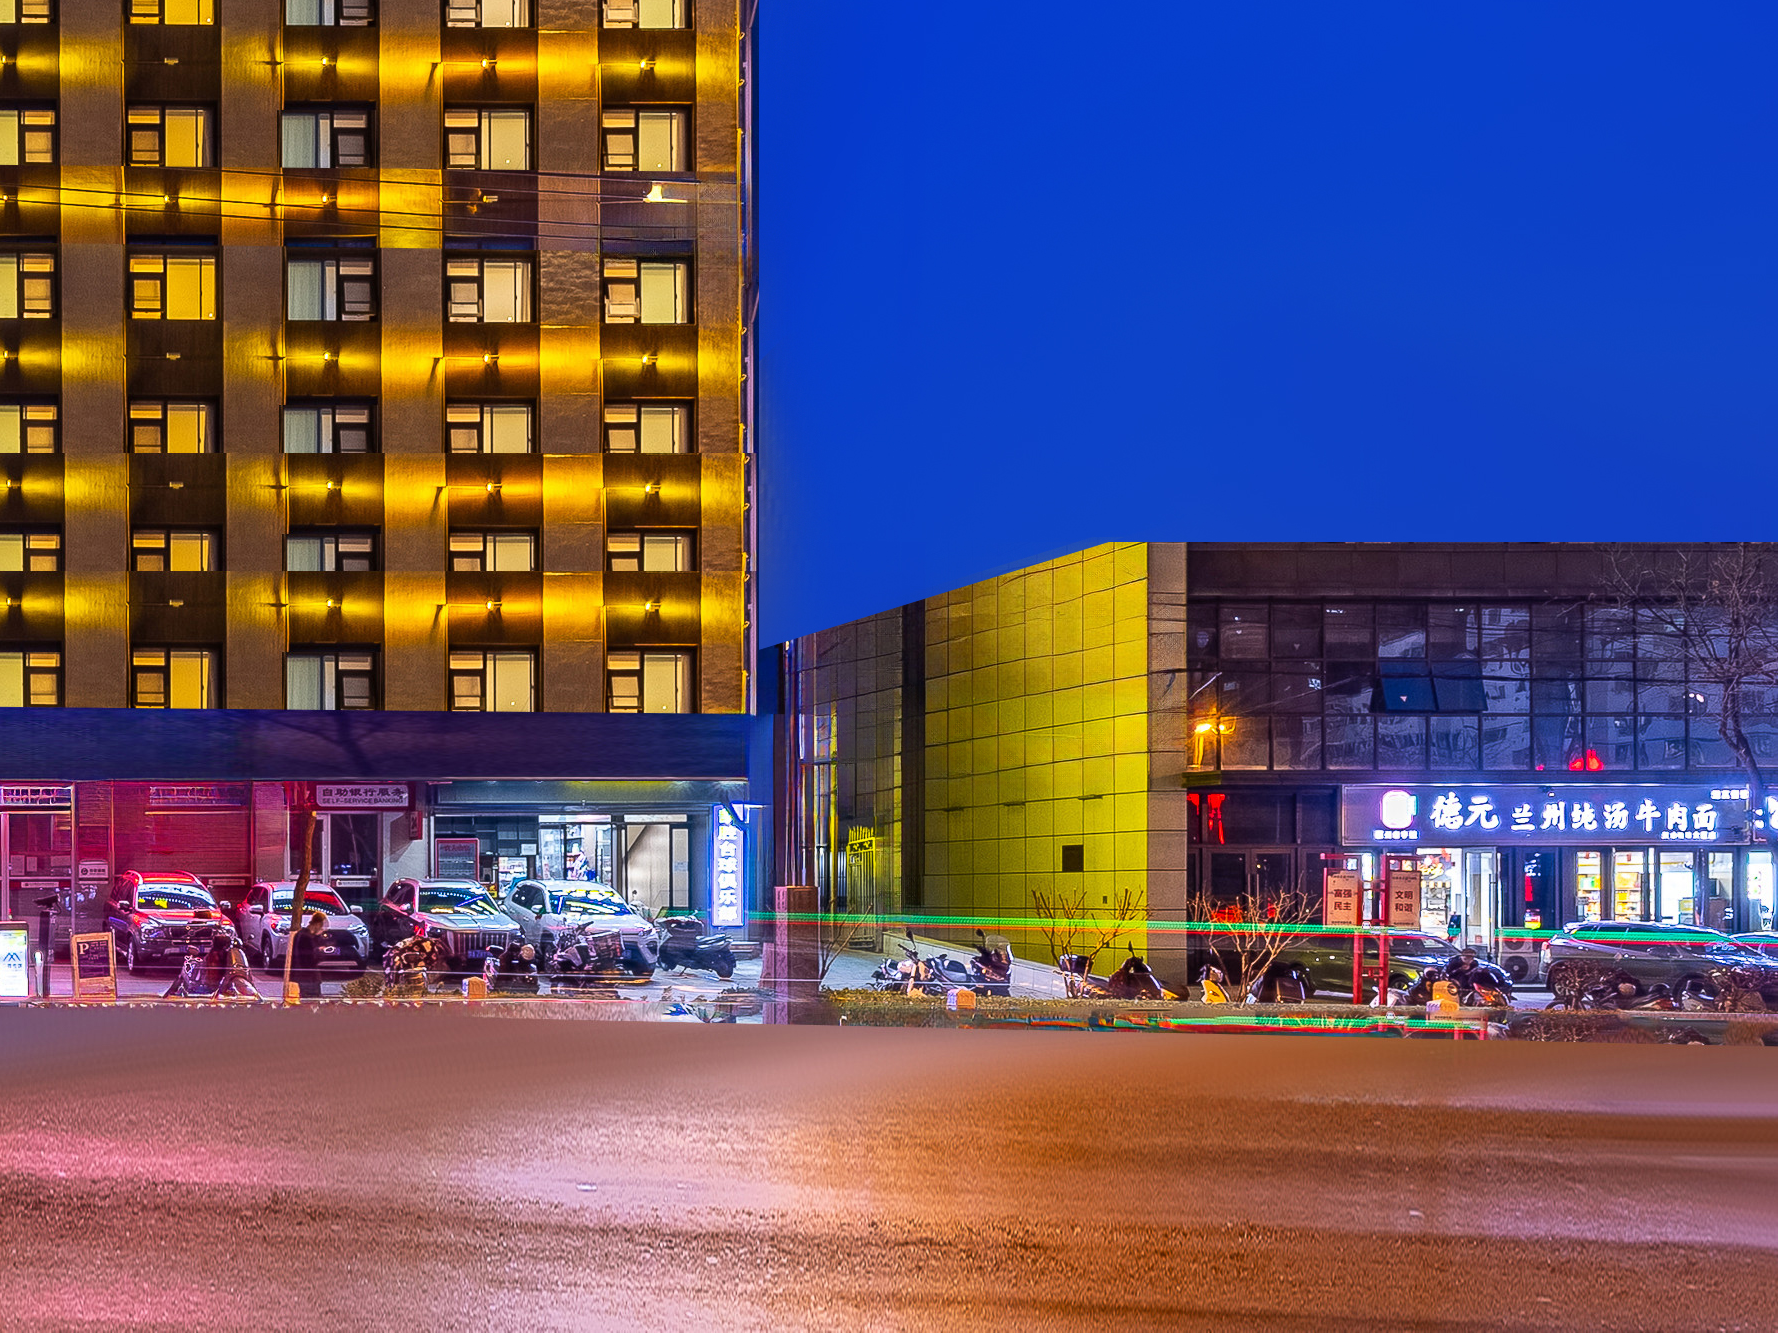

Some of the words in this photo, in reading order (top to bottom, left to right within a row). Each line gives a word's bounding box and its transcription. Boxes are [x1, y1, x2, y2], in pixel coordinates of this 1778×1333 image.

[322, 787, 405, 797] 自助银行服务
[1429, 791, 1501, 830] 德元
[1394, 890, 1414, 900] 文明
[1333, 901, 1352, 911] 民主
[1394, 903, 1413, 913] 和谐
